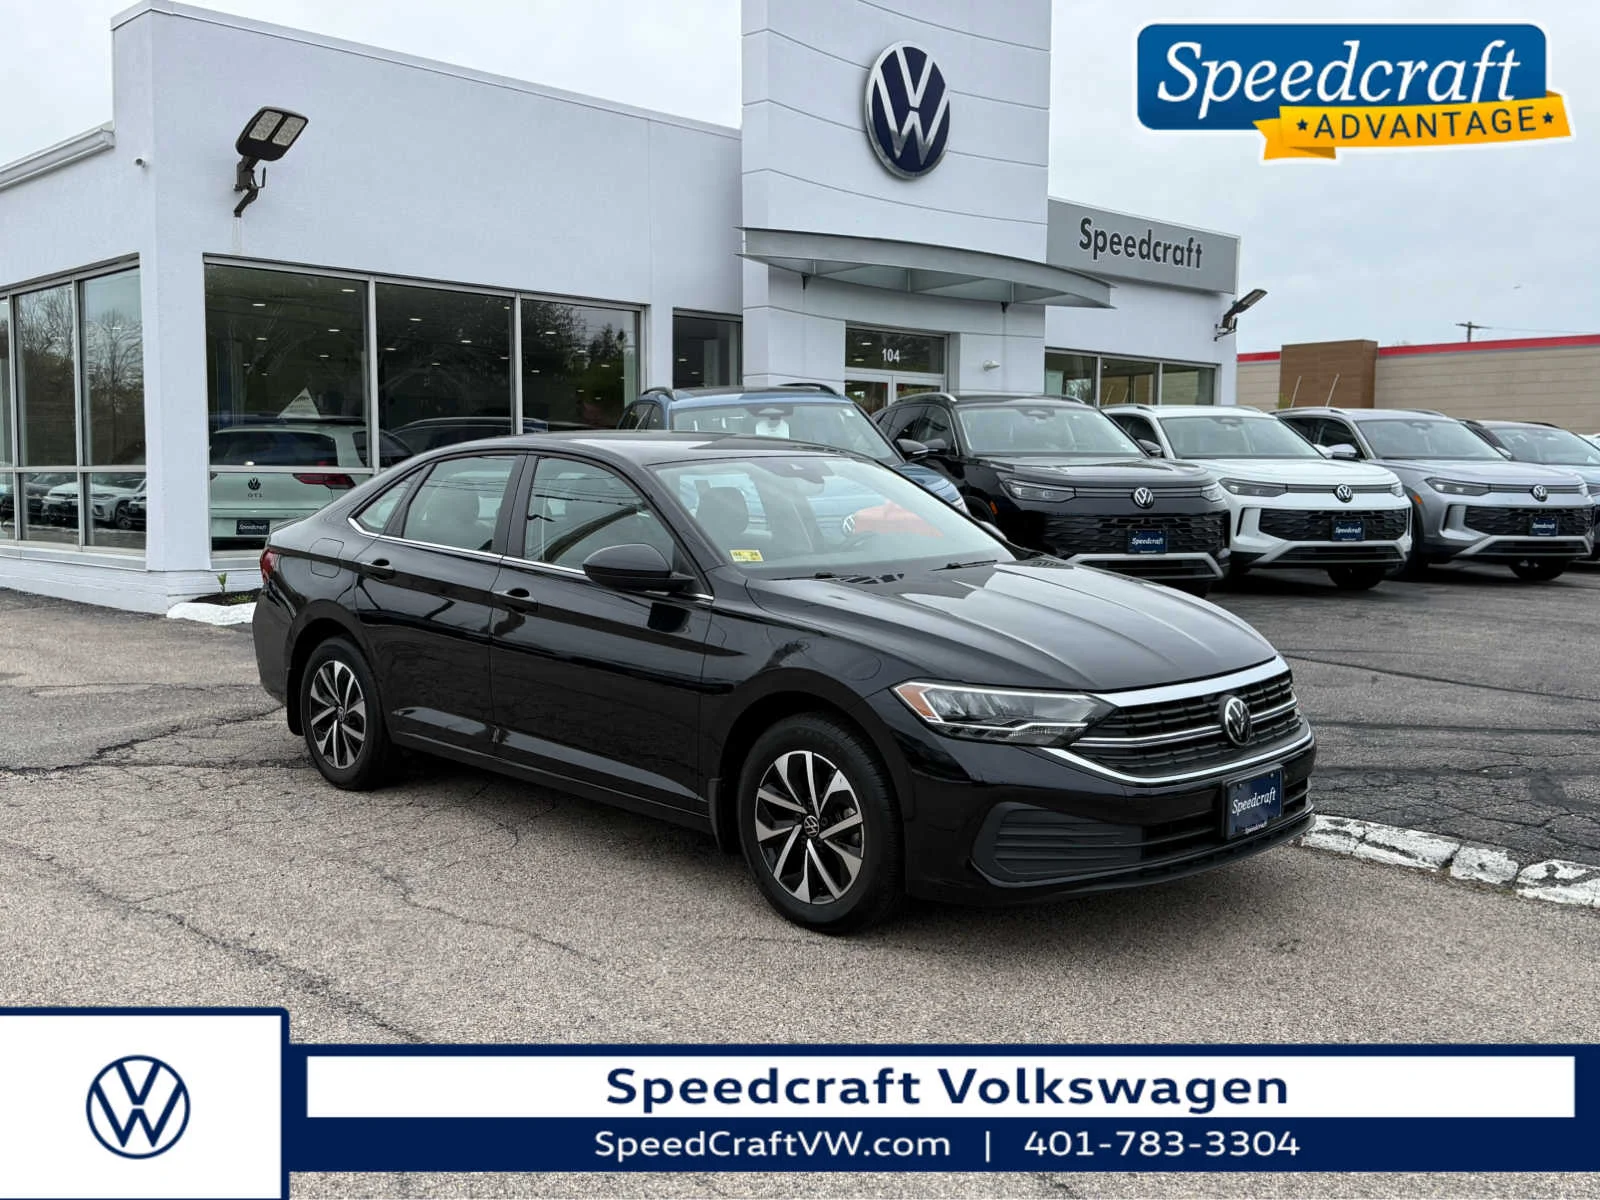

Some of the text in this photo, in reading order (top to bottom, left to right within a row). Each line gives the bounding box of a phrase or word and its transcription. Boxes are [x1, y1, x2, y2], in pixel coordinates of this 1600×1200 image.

[1079, 217, 1203, 269] Speedcraft
[882, 348, 901, 363] 104
[1131, 537, 1165, 545] Speedcraft
[1232, 786, 1276, 817] Speedcraft
